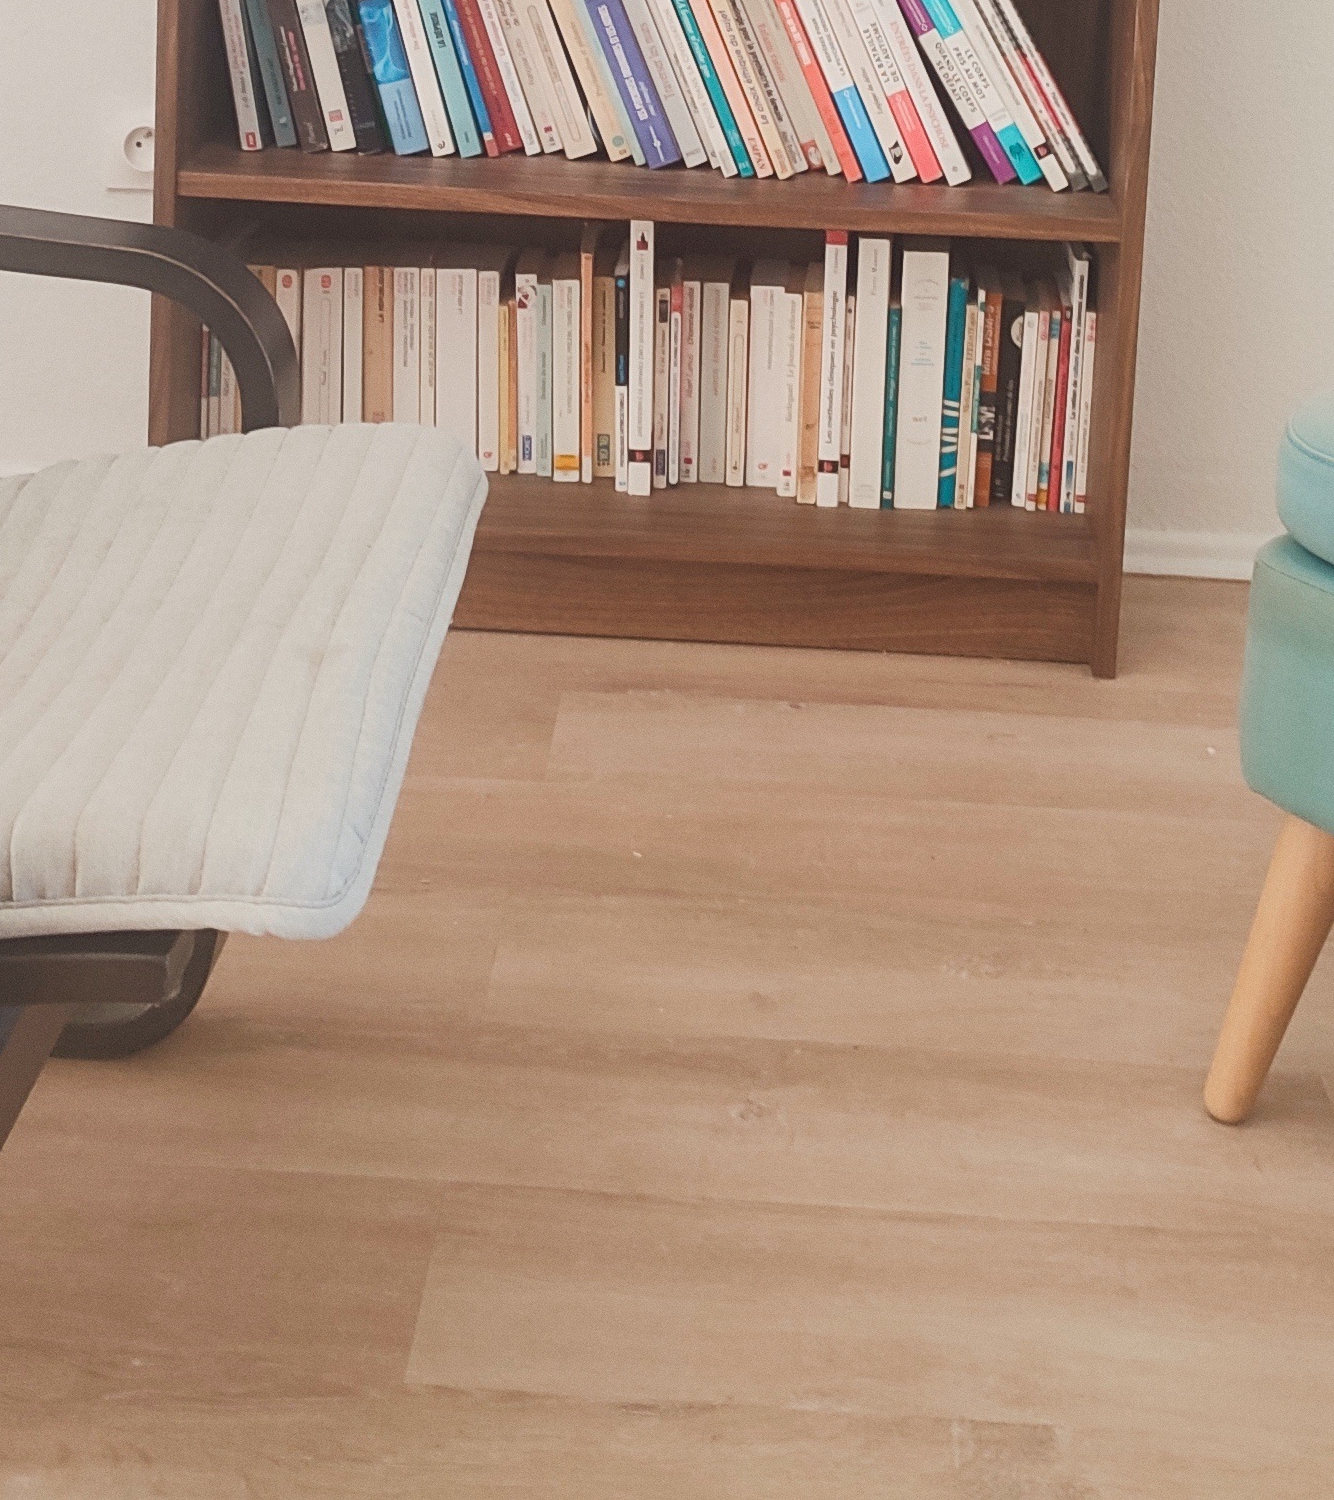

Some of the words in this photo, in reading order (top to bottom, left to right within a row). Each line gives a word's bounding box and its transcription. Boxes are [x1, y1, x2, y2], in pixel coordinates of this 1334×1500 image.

[717, 7, 734, 34] sujet
[726, 32, 739, 48] du
[858, 26, 887, 70] BATAILLE
[866, 19, 898, 69] L'AUTISME
[887, 18, 914, 63] ENTRÉES
[731, 47, 753, 86] éthique
[878, 69, 891, 84] LA
[889, 69, 901, 83] DE
[906, 62, 925, 91] DANS
[933, 40, 956, 73] QUAND
[950, 71, 962, 85] LE
[957, 83, 978, 114] CORPS
[934, 59, 945, 72] SE
[941, 70, 964, 103] DÉFAIT
[951, 45, 967, 67] PRIS
[962, 65, 975, 81] AU
[970, 79, 986, 101] MOT
[963, 47, 974, 61] LE
[969, 59, 990, 90] CORPS
[745, 83, 764, 114] choix
[917, 88, 930, 103] LA
[756, 112, 769, 126] Le
[922, 101, 951, 150] PSYCHOSE
[746, 134, 767, 172] EMPAN
[824, 429, 832, 444] Les
